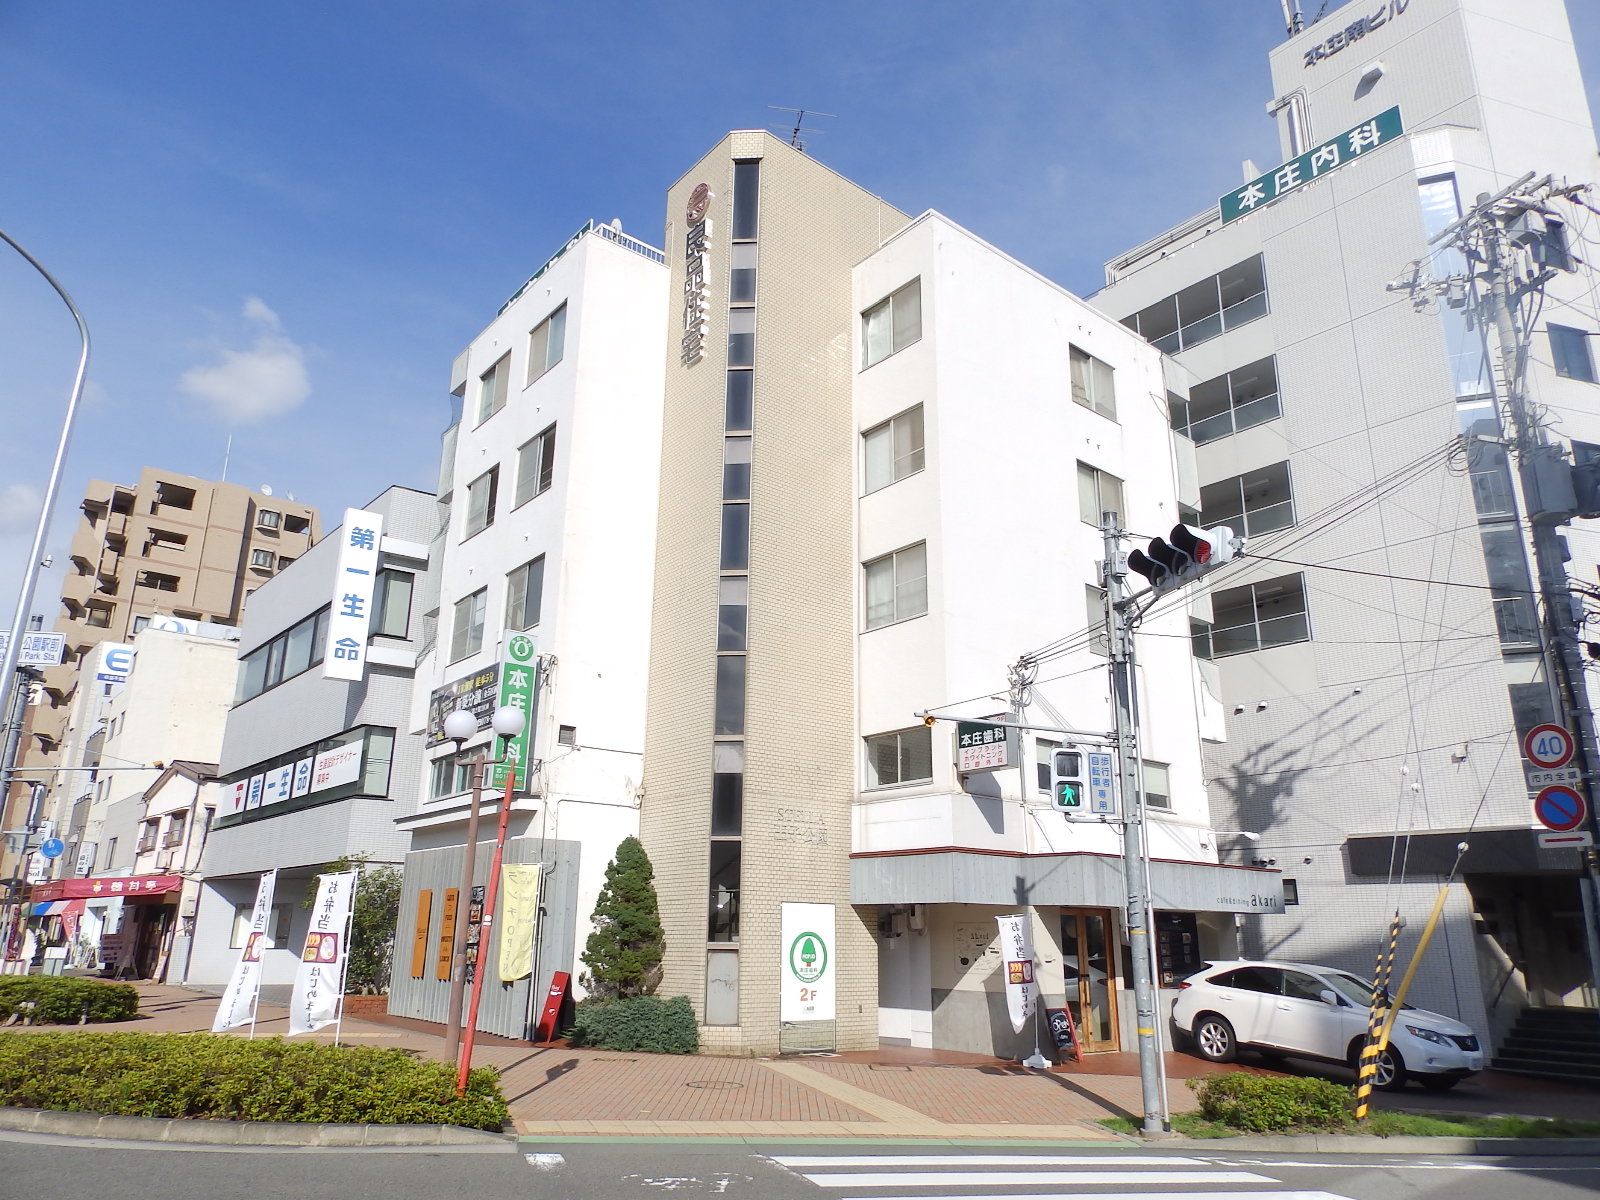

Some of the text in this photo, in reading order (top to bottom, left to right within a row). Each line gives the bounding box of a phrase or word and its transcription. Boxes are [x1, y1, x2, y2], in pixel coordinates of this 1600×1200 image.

[1303, 0, 1410, 68] 本庄南ビル
[1237, 119, 1382, 211] 本庄内科
[333, 525, 375, 662] 第一生命
[24, 651, 40, 661] Park
[501, 668, 529, 764] 本庄科
[960, 726, 1005, 747] 本庄歯科
[1537, 736, 1562, 756] 40
[964, 750, 1003, 762] ホワイトニング
[1091, 756, 1101, 786] 自転車
[1100, 757, 1110, 787] 歩行者
[1531, 771, 1578, 783] 市内全域
[1097, 789, 1108, 810] 専用
[1250, 894, 1277, 907] akari
[800, 987, 817, 1002] 2F
